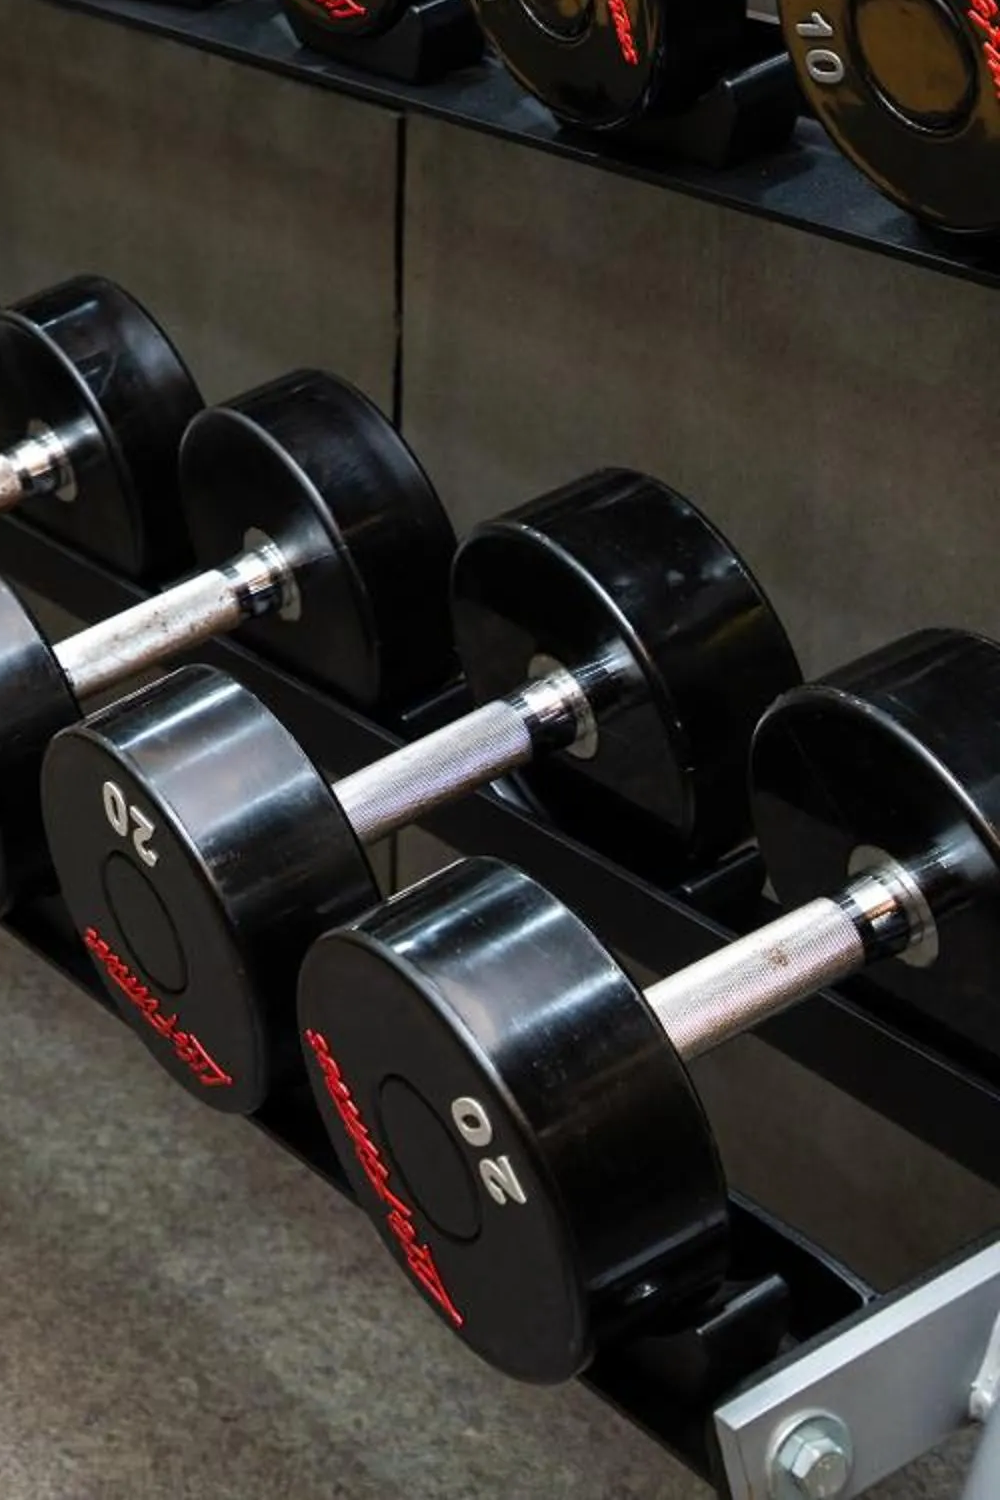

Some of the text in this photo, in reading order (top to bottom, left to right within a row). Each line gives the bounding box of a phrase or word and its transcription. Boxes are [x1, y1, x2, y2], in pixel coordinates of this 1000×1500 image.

[795, 11, 844, 84] 10
[102, 780, 158, 868] 20
[450, 1096, 527, 1205] 20
